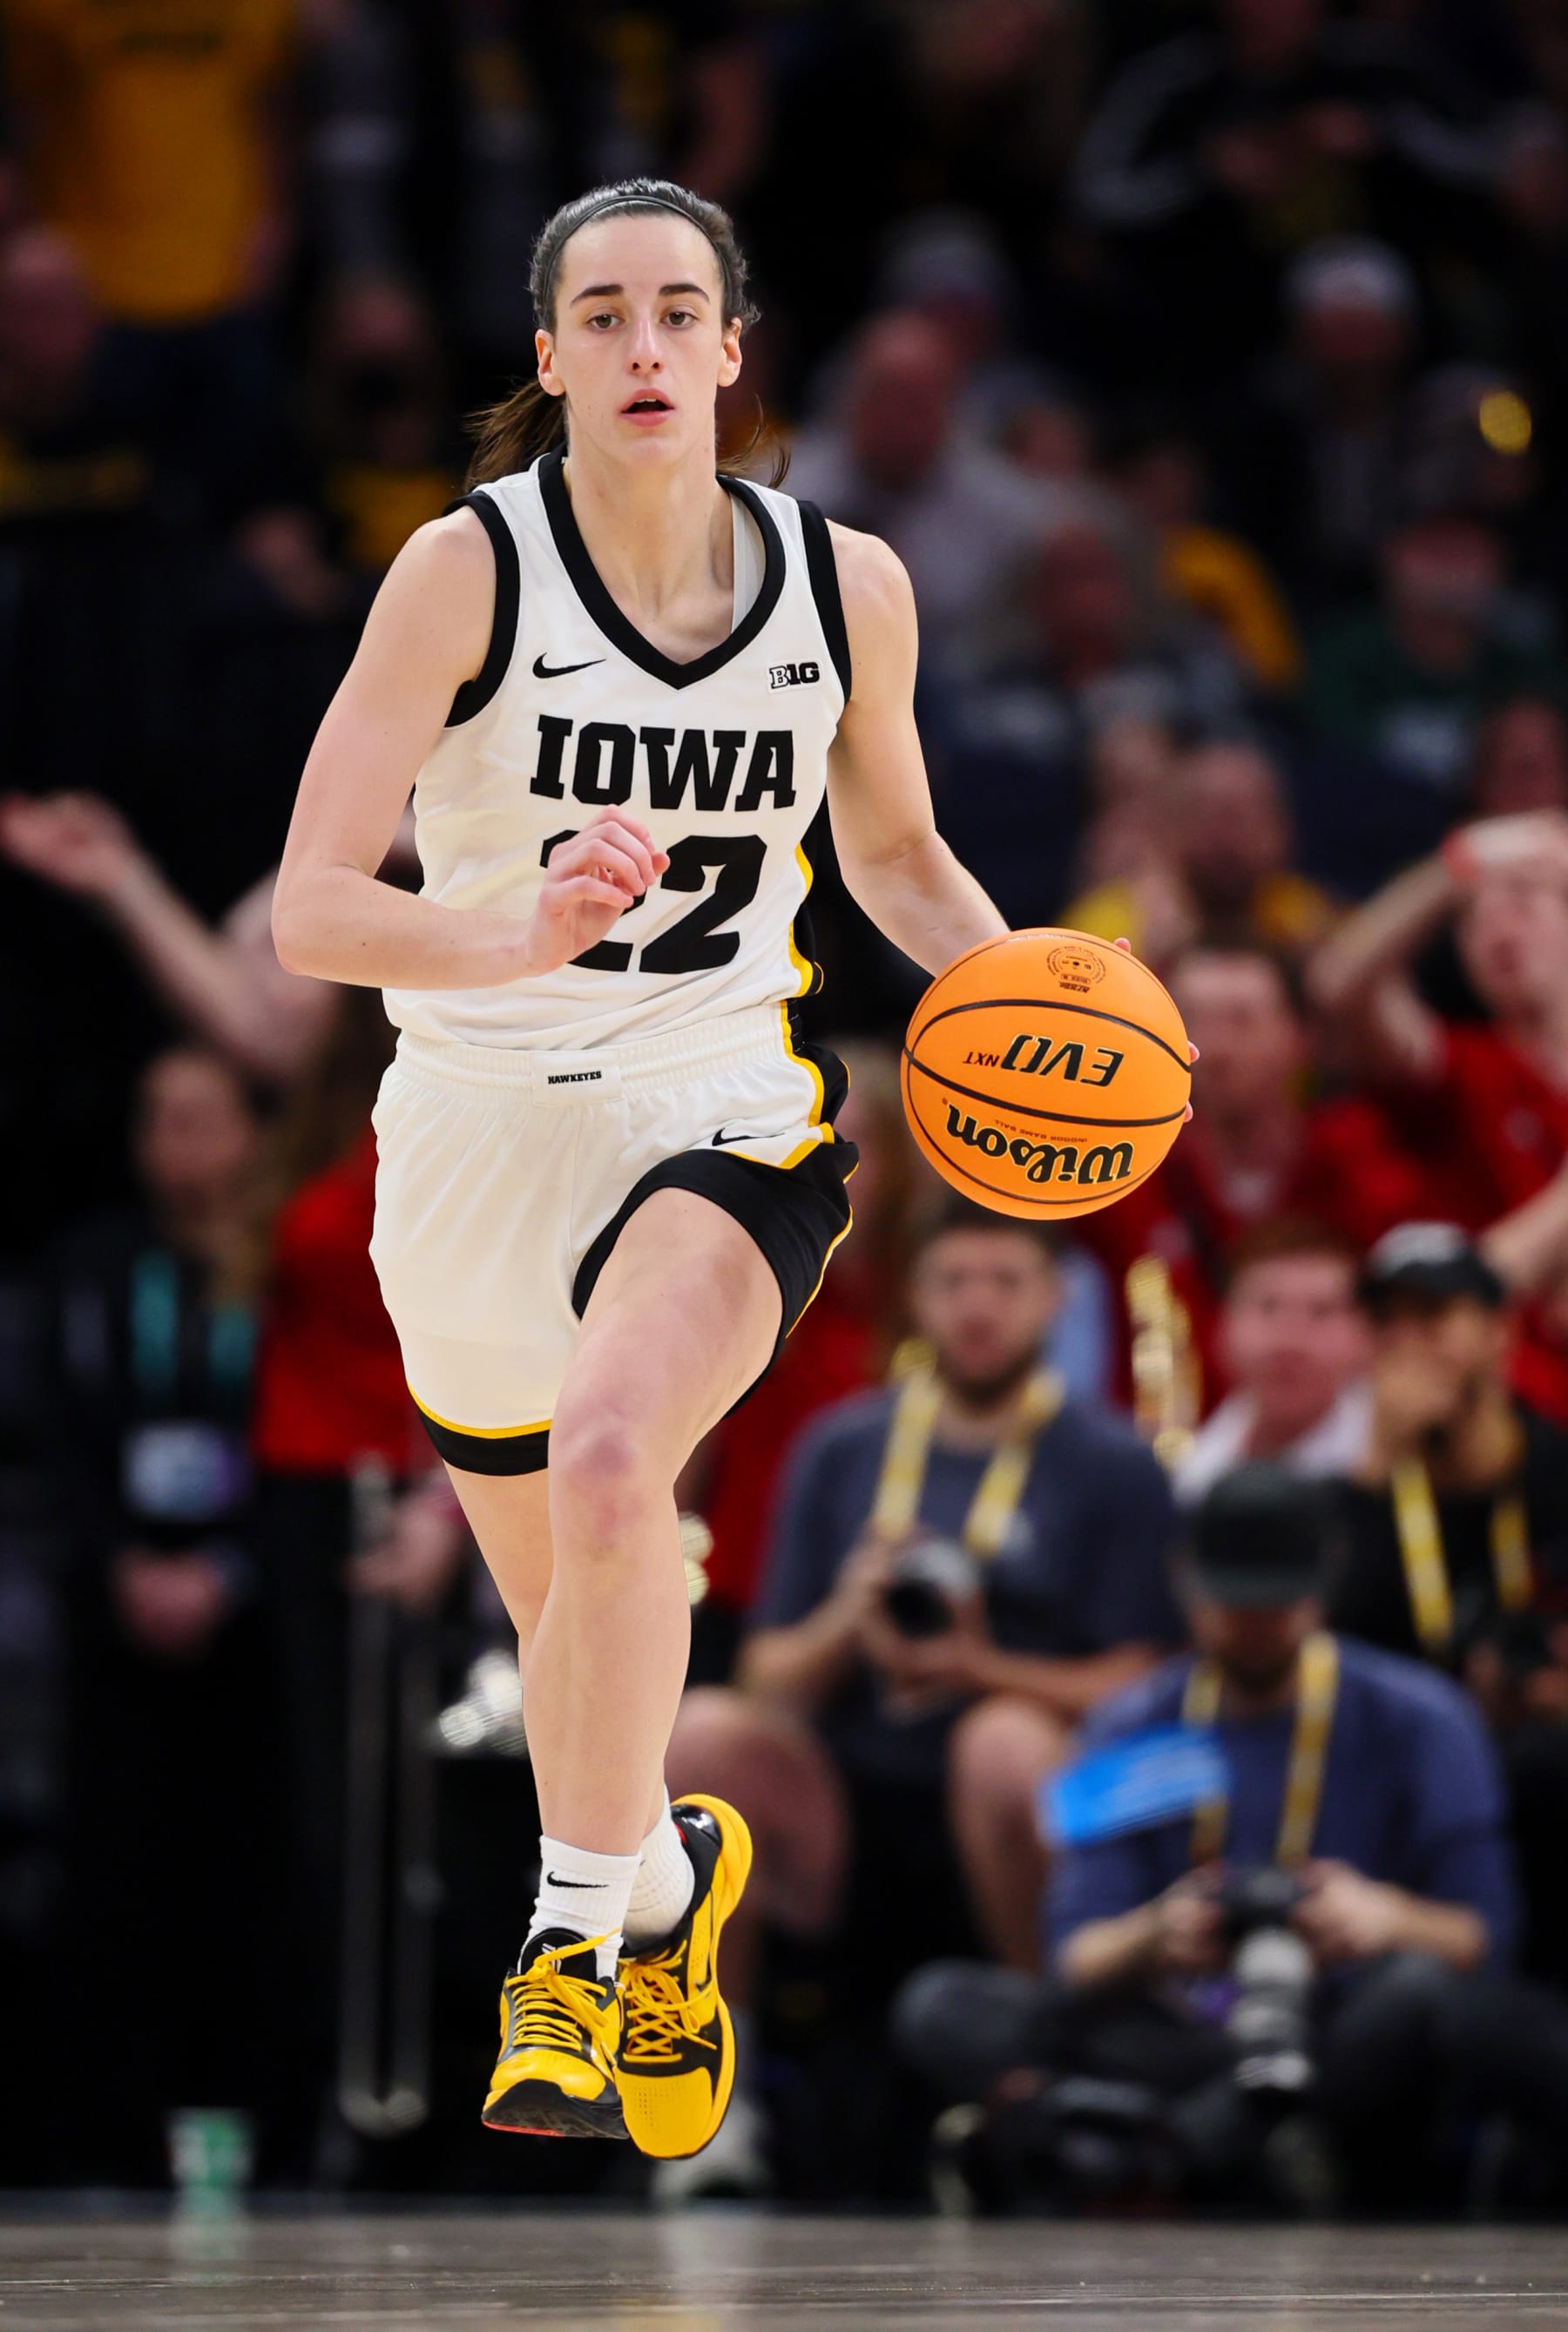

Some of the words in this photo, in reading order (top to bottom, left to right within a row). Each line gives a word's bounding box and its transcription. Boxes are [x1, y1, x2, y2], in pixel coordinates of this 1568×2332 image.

[530, 713, 796, 812] IOWA
[962, 1051, 1000, 1067] NXT
[1001, 1033, 1124, 1087] EVO
[548, 1071, 602, 1085] HAWKEYES
[994, 1119, 1017, 1132] BALL
[946, 1104, 1133, 1185] Wilson
